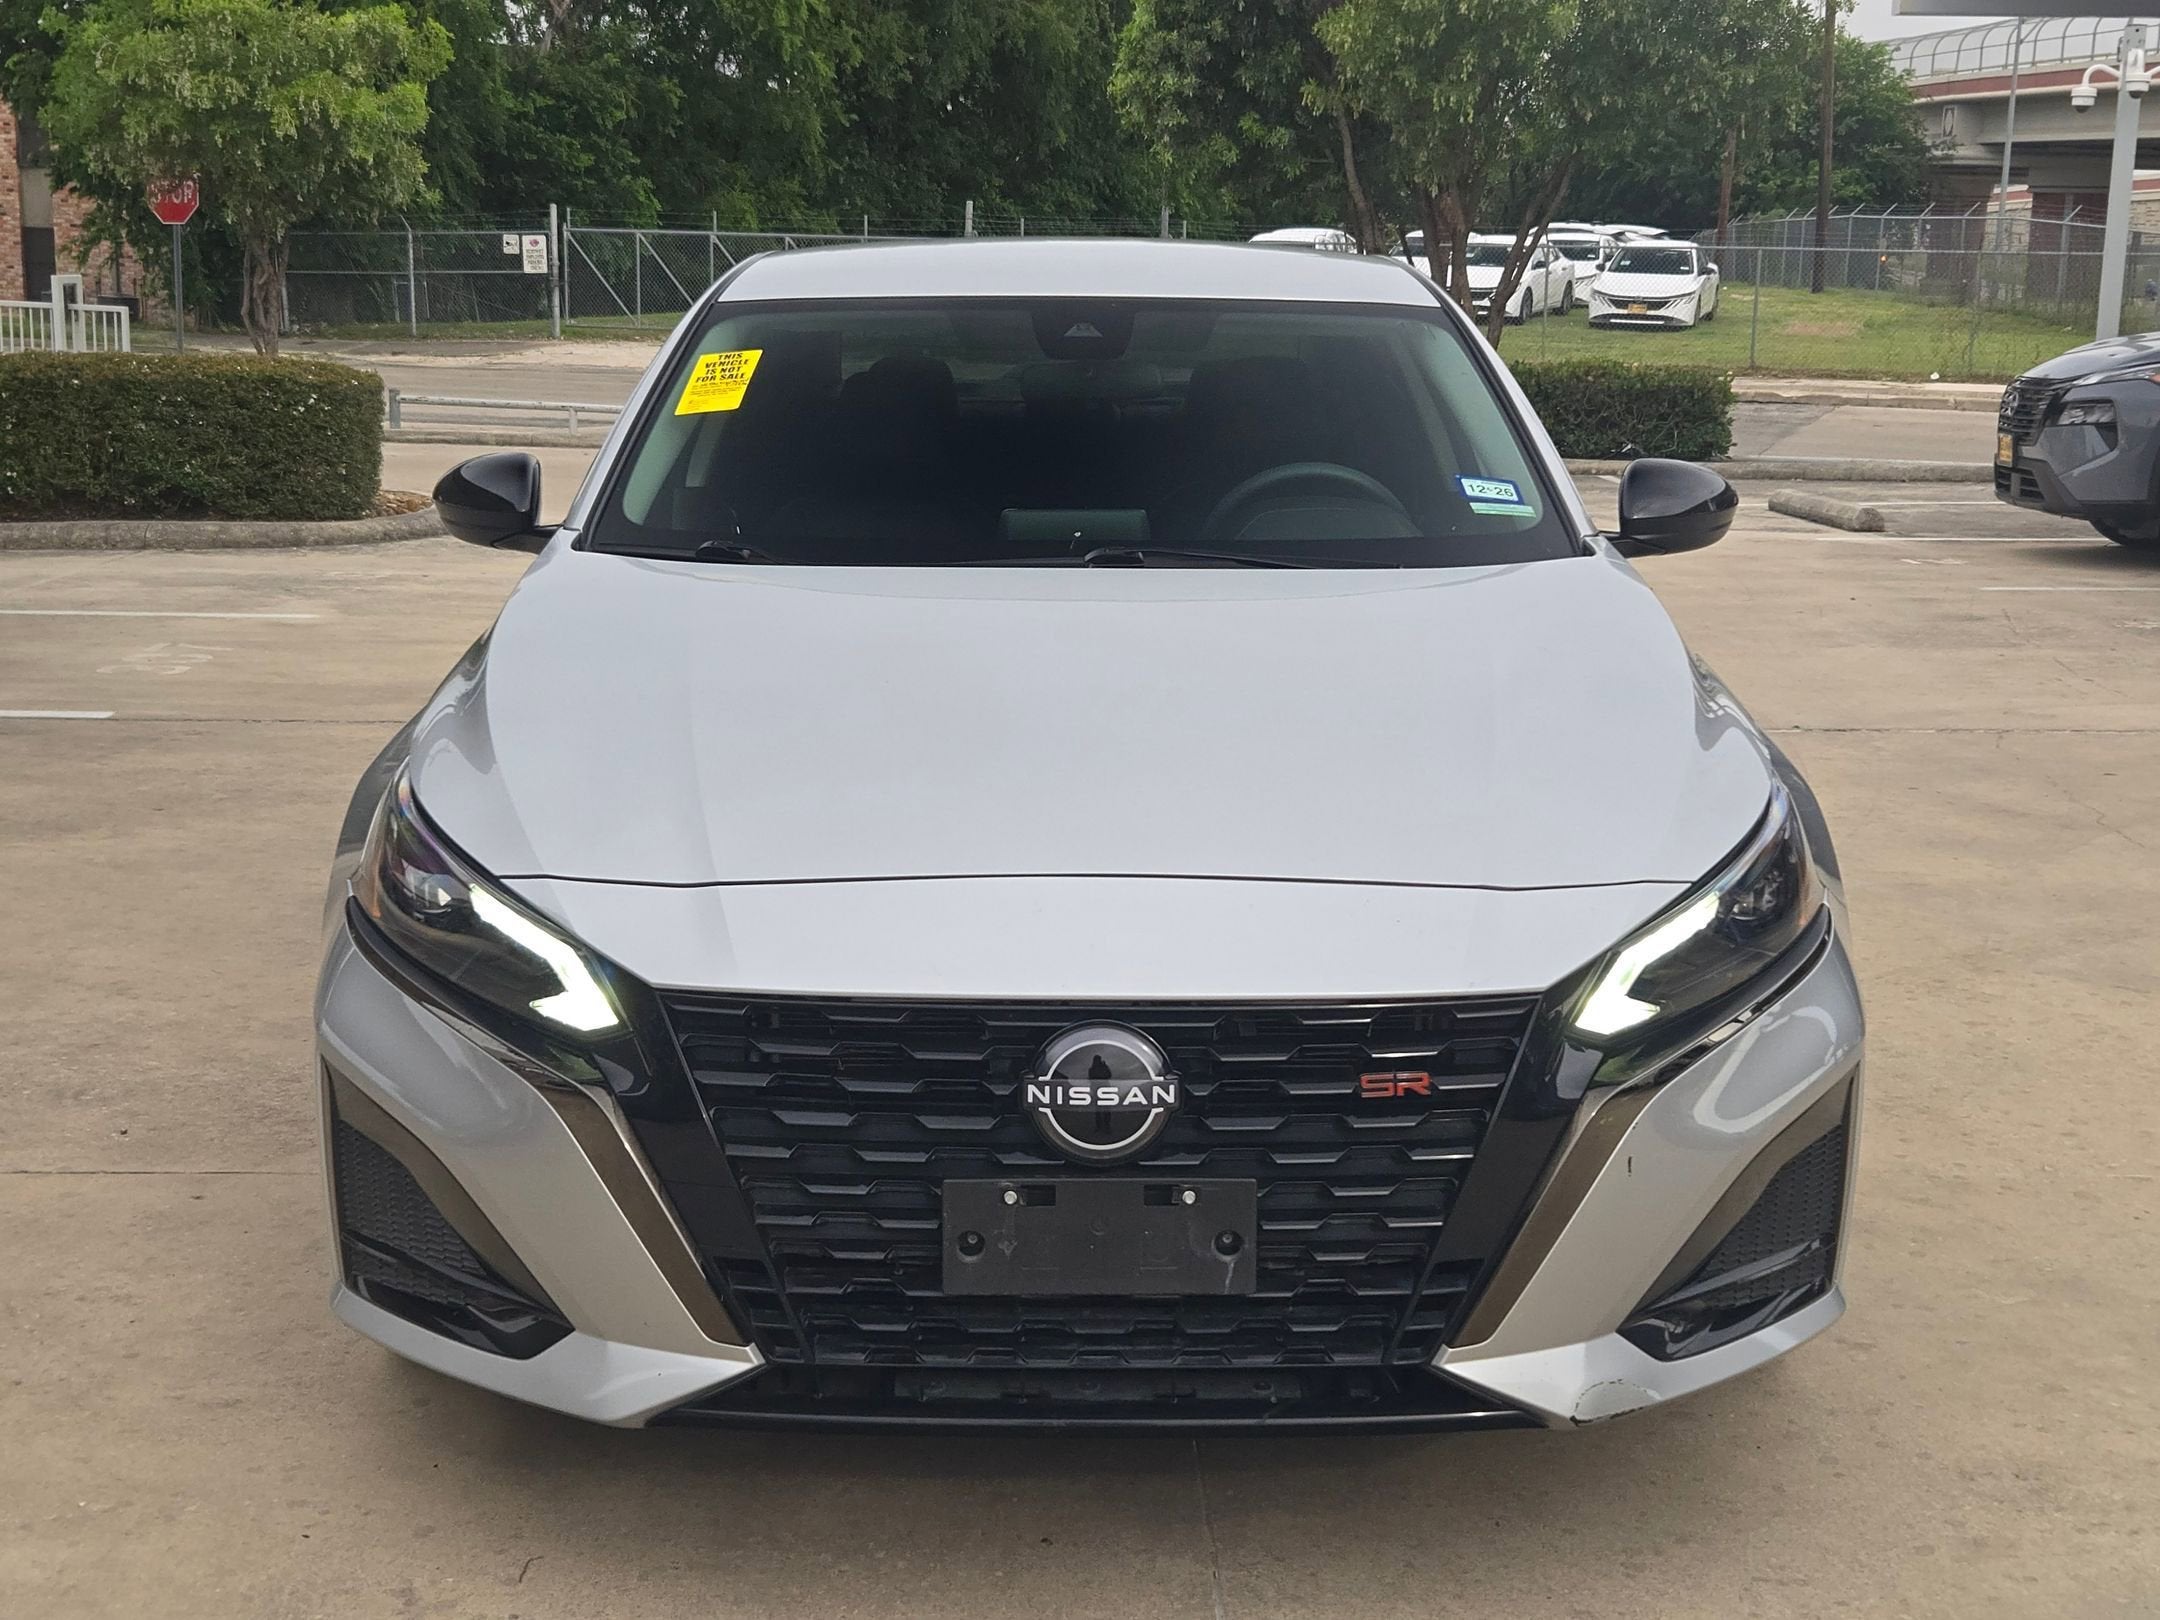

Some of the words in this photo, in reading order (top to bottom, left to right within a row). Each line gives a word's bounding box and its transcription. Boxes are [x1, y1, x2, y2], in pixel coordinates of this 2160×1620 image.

[718, 353, 744, 361] THIS
[705, 359, 749, 369] VEHICLE
[720, 366, 743, 374] NOT
[695, 375, 717, 383] FOR
[719, 372, 747, 381] SALE
[1360, 1071, 1432, 1098] SR
[1027, 1084, 1175, 1106] NISSAN
